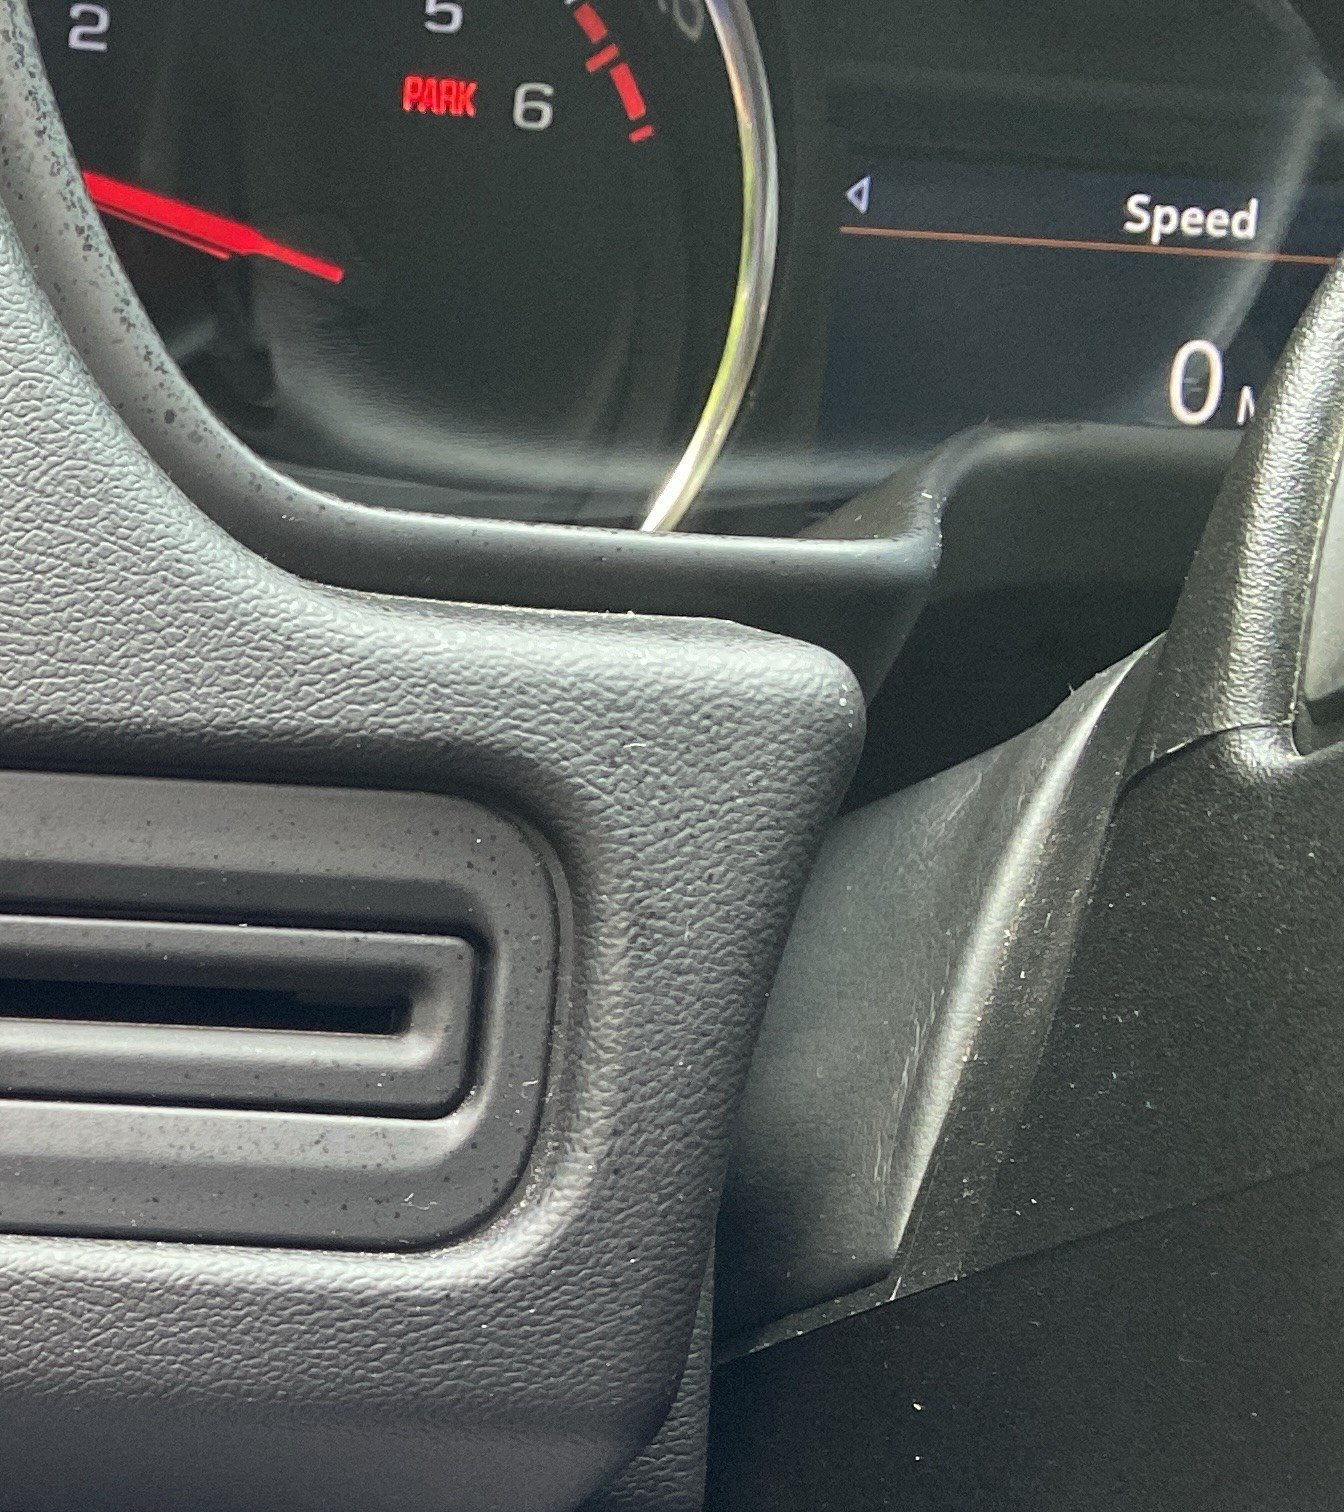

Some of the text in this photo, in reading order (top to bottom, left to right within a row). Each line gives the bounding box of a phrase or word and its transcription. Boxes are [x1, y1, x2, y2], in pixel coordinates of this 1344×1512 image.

[69, 3, 110, 52] 2
[424, 0, 463, 34] 5
[402, 74, 478, 118] PARK
[513, 82, 554, 131] 6
[1123, 193, 1259, 244] Speed
[1169, 339, 1223, 426] 0
